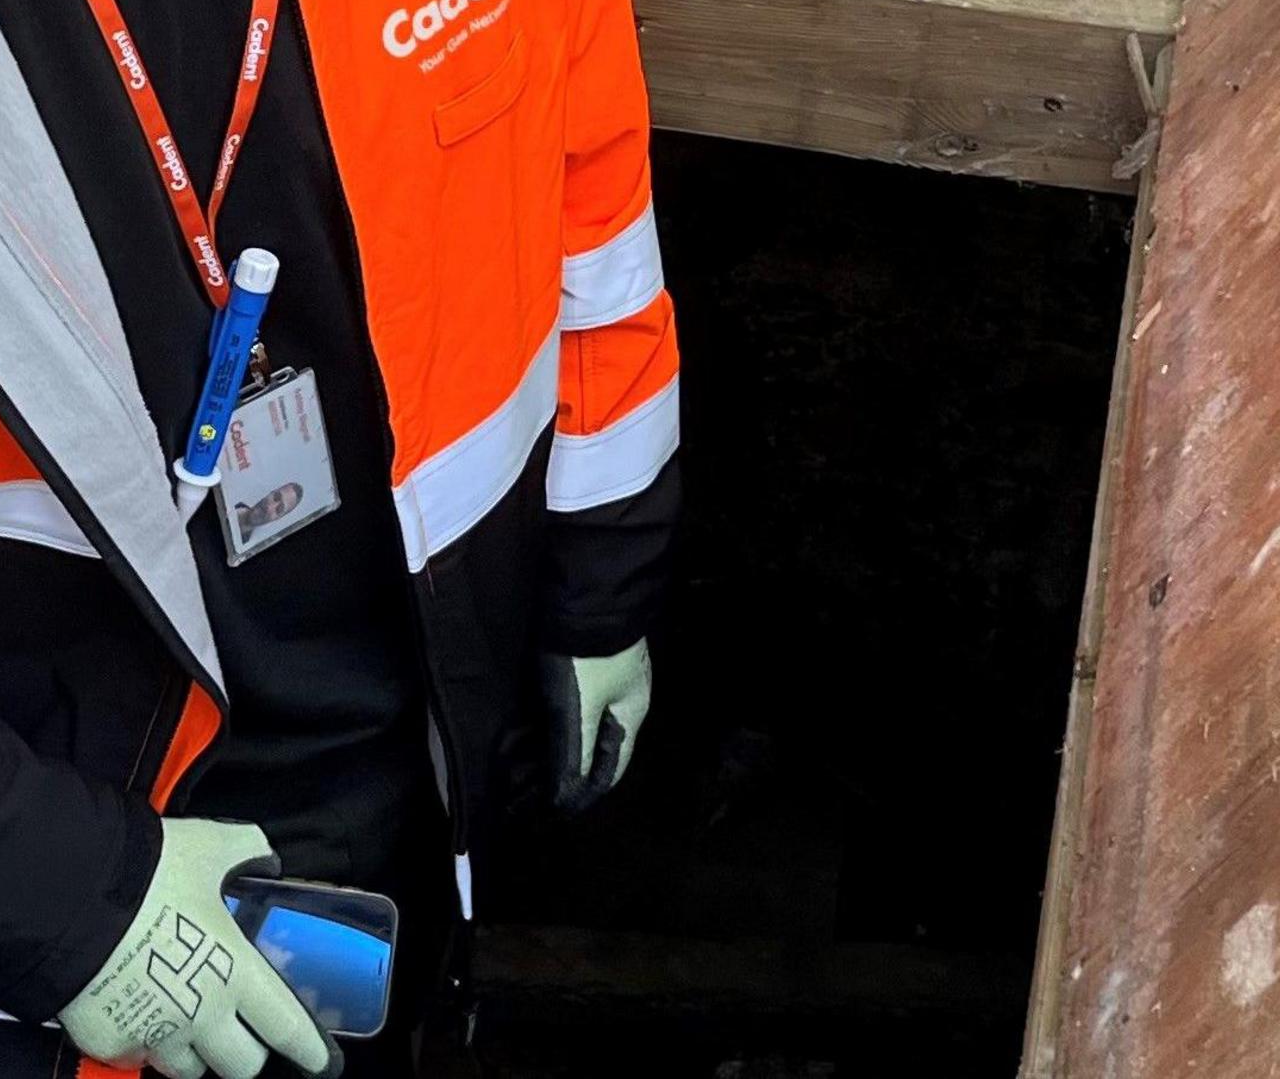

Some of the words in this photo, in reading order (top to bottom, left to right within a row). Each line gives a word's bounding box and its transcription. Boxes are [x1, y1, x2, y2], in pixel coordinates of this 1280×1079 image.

[111, 29, 146, 90] Cadent
[244, 17, 270, 81] Cadent
[418, 46, 447, 75] Your
[156, 135, 190, 191] Cadent
[193, 234, 226, 287] Cadent
[229, 419, 251, 472] Cadent
